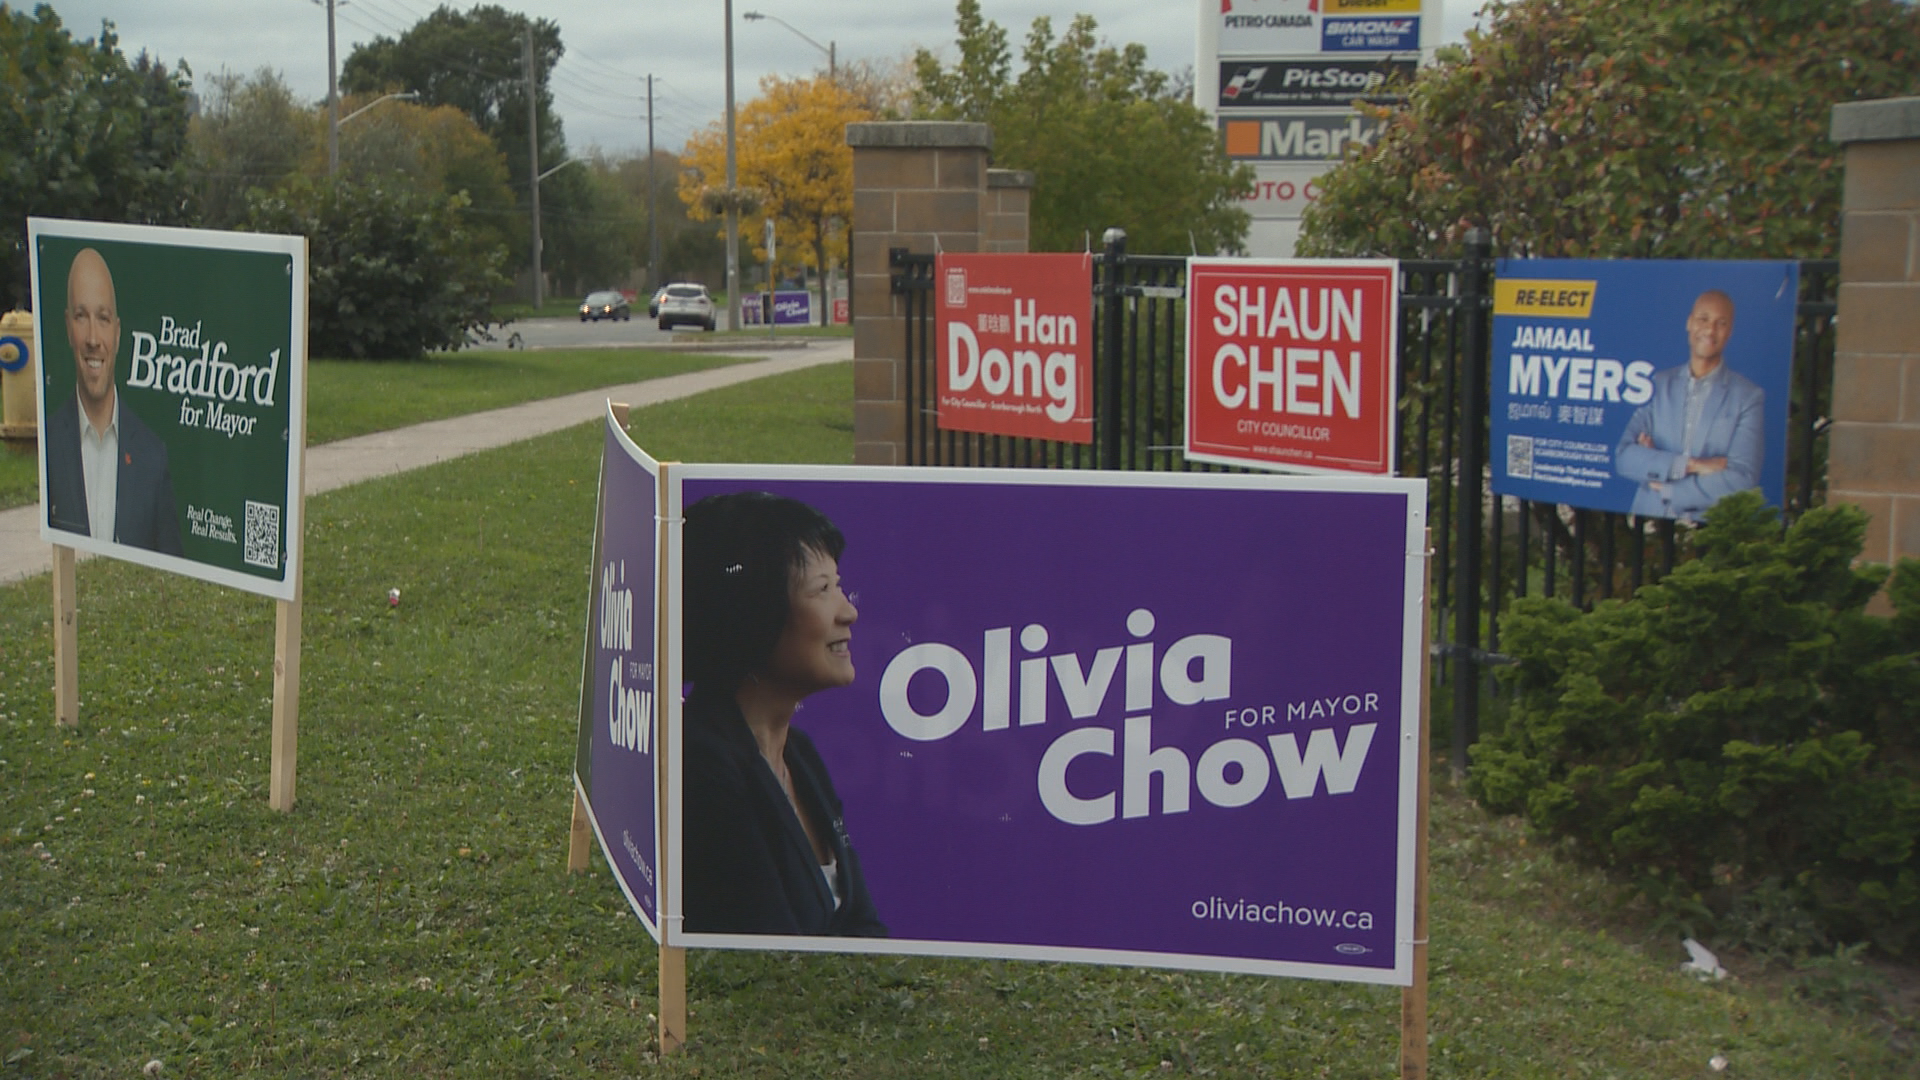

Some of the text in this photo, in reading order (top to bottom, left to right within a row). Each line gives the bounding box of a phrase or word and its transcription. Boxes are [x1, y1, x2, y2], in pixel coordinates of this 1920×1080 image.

[1342, 36, 1400, 47] CAR WASH
[1282, 68, 1385, 91] PitStop
[1262, 118, 1388, 157] Mark'
[1240, 181, 1296, 201] UTO
[1213, 284, 1363, 343] SHAUN
[1515, 289, 1590, 307] RE-ELECT
[159, 316, 202, 349] Brad
[1014, 298, 1078, 346] Han
[1511, 326, 1595, 352] JAMAAL
[126, 331, 281, 407] Bradford
[947, 321, 1077, 424] Dong
[1212, 343, 1361, 420] CHEN
[1508, 353, 1656, 406] MYERS
[179, 397, 257, 440] for Mayor
[1237, 419, 1331, 441] CITY COUNCILLOR
[187, 504, 205, 522] Real
[191, 520, 209, 538] Real
[601, 559, 633, 652] Olivia
[630, 661, 652, 682] FOR MAYOR
[879, 608, 1233, 742] Olivia
[609, 655, 652, 755] Chow
[1225, 692, 1379, 730] FOR MAYOR
[1037, 715, 1378, 826] Chow
[1191, 896, 1374, 931] oliviachow.ca
